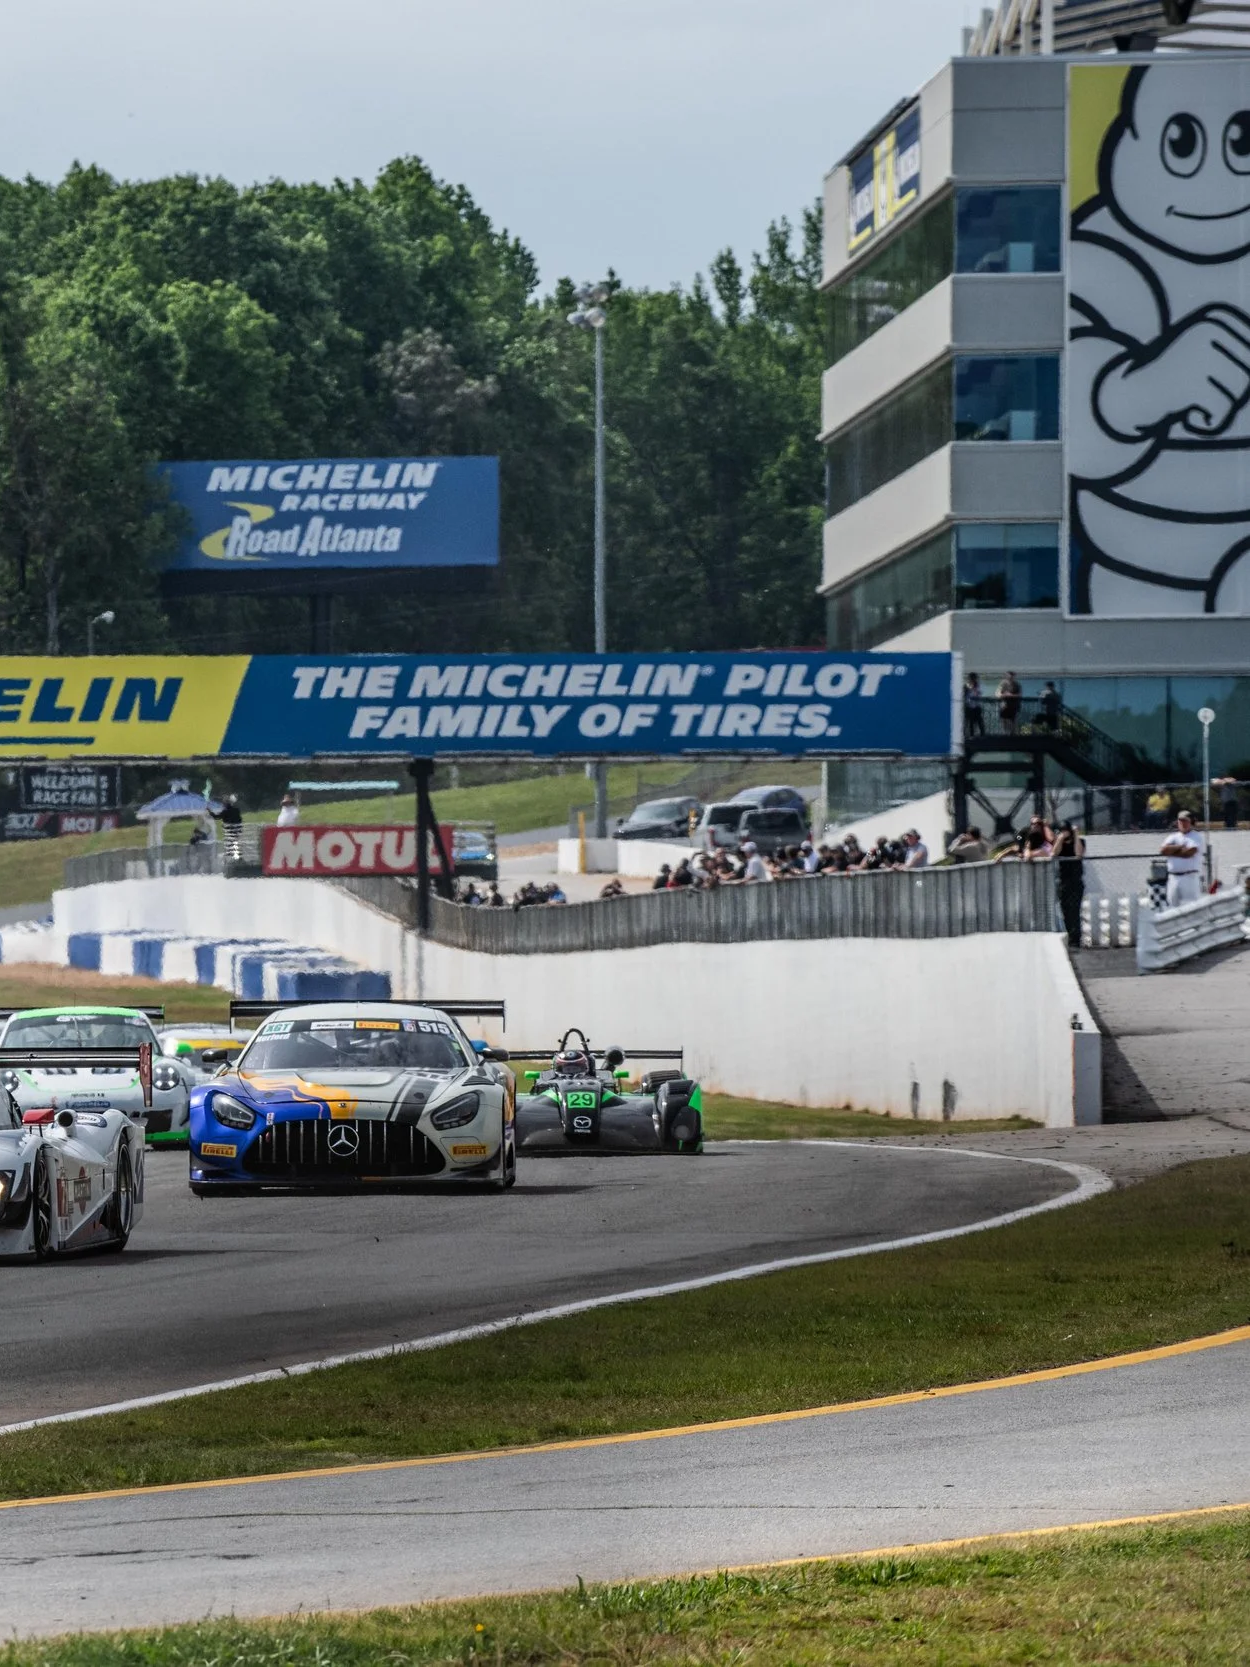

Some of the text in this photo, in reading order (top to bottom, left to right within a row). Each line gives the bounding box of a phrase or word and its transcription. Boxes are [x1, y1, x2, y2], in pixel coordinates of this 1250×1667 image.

[206, 463, 440, 492] MICHELIN
[279, 493, 427, 511] RACEWAY
[292, 666, 402, 699] THE
[349, 703, 842, 738] FAMILY OF TIRES.
[418, 1021, 450, 1035] 515
[570, 1093, 593, 1106] 29
